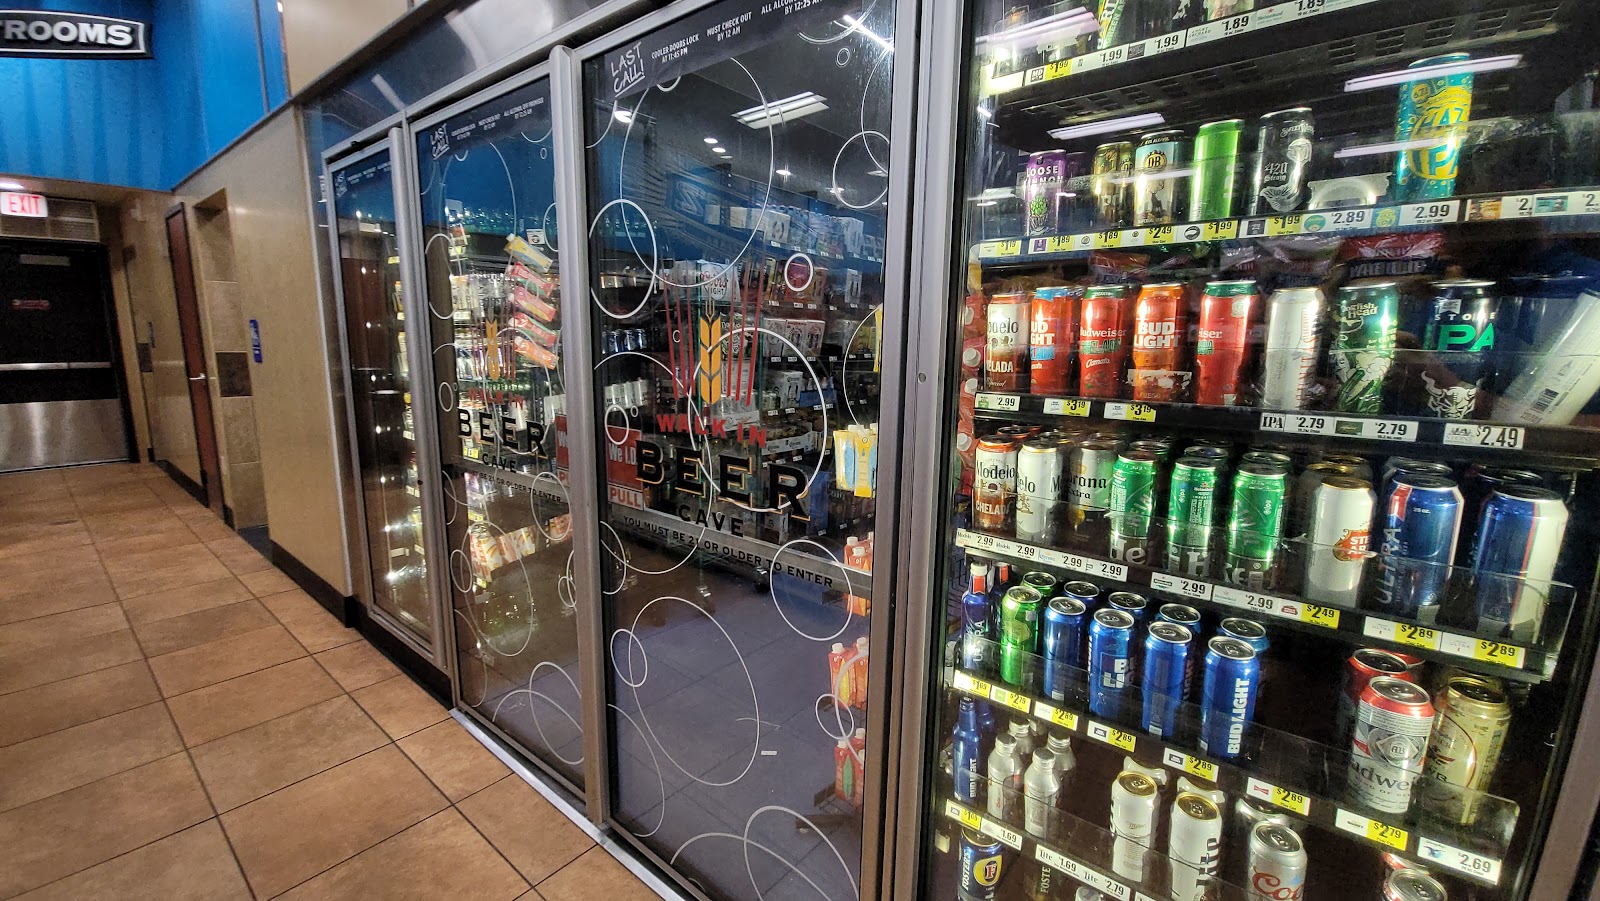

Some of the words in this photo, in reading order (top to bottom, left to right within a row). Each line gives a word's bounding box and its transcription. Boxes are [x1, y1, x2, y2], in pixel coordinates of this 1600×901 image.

[0, 20, 133, 46] ROOMS
[706, 24, 721, 37] MUST
[722, 17, 740, 32] CHECK
[740, 12, 752, 24] OUT
[717, 32, 725, 42] BY
[725, 29, 732, 40] 12
[732, 26, 741, 37] AM
[651, 47, 669, 60] COOLER
[669, 39, 686, 53] DOORS
[686, 33, 700, 46] LOCK
[662, 55, 668, 64] AT
[680, 47, 688, 57] PM
[611, 42, 642, 76] LAST
[613, 59, 646, 93] CALL!
[1264, 162, 1288, 175] 420
[8, 193, 40, 214] EXIT
[1031, 321, 1049, 334] UD
[1137, 322, 1176, 336] BUD
[1134, 335, 1181, 349] LIGHT
[457, 407, 549, 459] BEER
[656, 413, 728, 440] WALK
[737, 422, 767, 449] IN
[1262, 415, 1284, 429] IPA
[482, 453, 516, 473] CAVE
[608, 442, 622, 462] We
[636, 440, 811, 521] BEER
[976, 460, 1016, 480] Modelo
[506, 480, 528, 494] OLDER
[528, 487, 538, 498] TO
[538, 490, 561, 503] ENTER
[609, 489, 642, 509] PULL
[678, 504, 744, 538] CAVE
[623, 515, 641, 528] YOU
[644, 521, 670, 536] MUST
[672, 530, 686, 541] BE
[688, 536, 699, 547] 21
[704, 540, 719, 552] OR
[722, 546, 762, 566] OLDER
[766, 558, 782, 572] TO
[787, 565, 833, 589] ENTER
[1231, 677, 1250, 722] LIGHT
[1227, 723, 1244, 754] BUD
